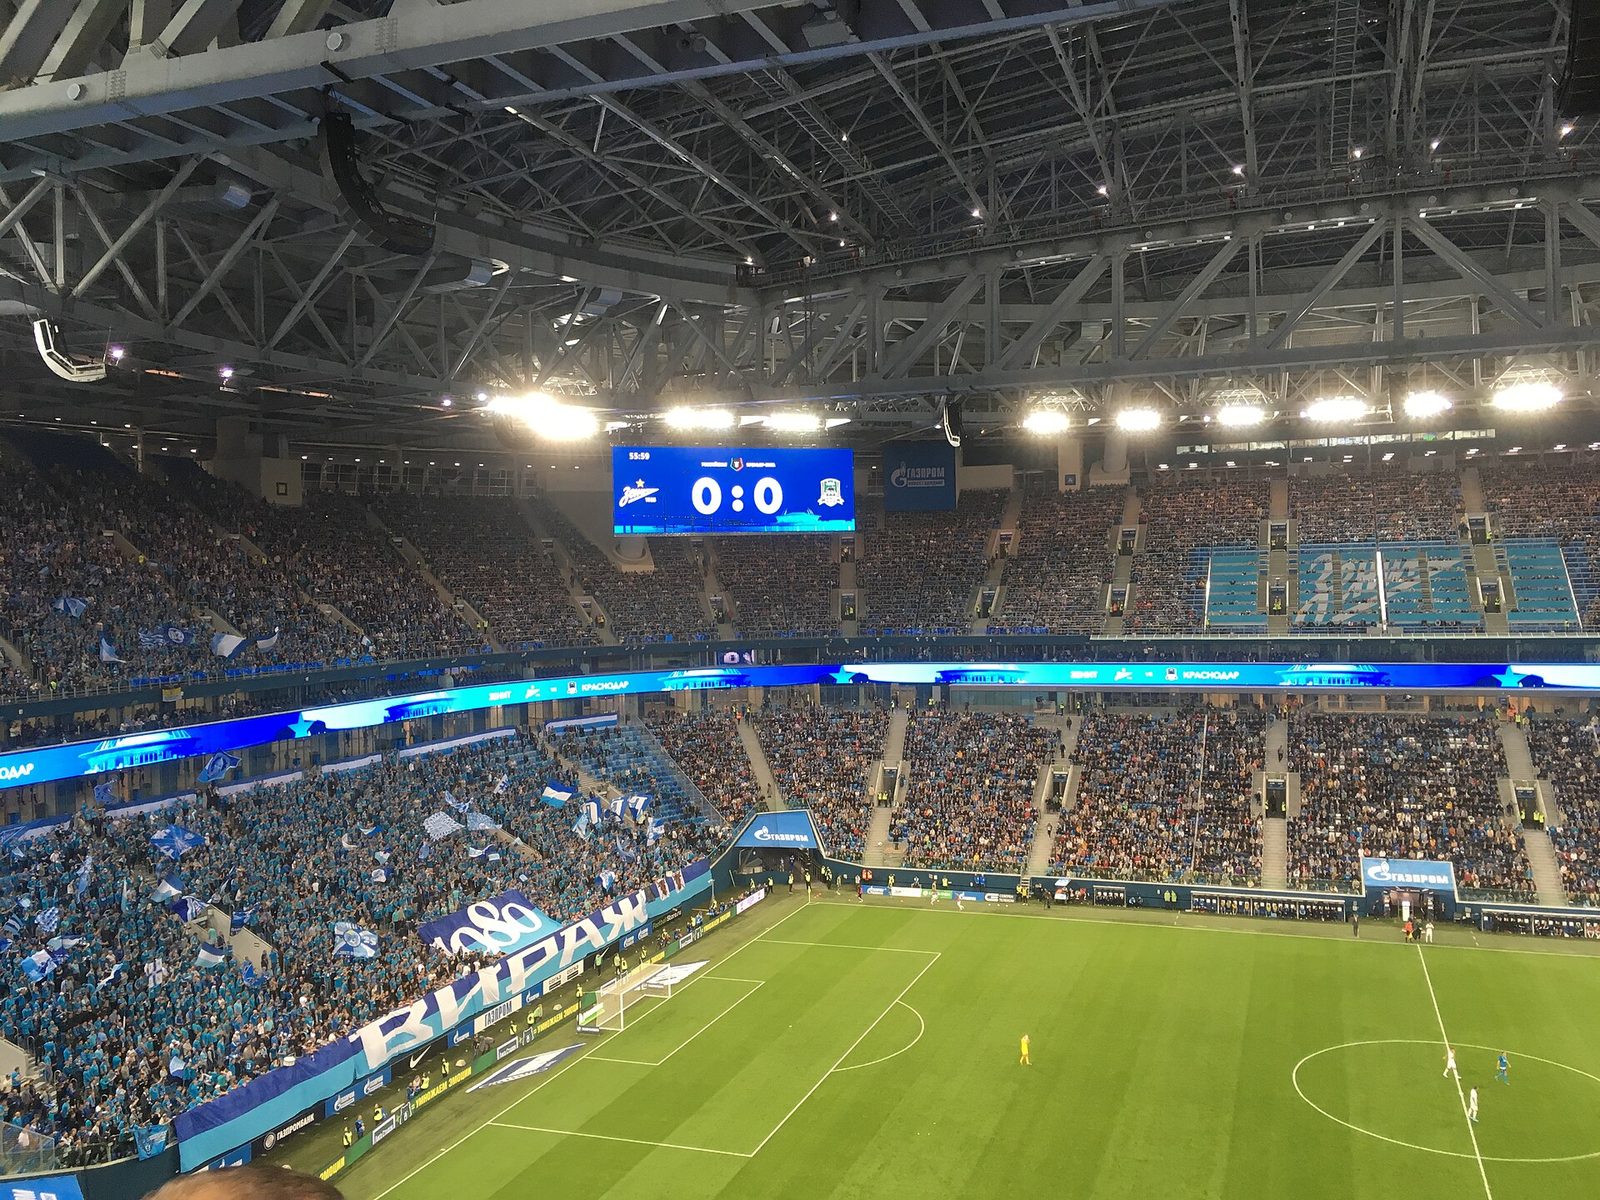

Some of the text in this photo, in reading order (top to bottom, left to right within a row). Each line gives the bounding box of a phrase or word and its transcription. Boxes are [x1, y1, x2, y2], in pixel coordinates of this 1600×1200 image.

[1392, 873, 1449, 884] ГАЗПРОМ
[485, 1000, 512, 1027] ГАЗПРОМ
[276, 1113, 315, 1141] ГАЗПРОМБАНК
